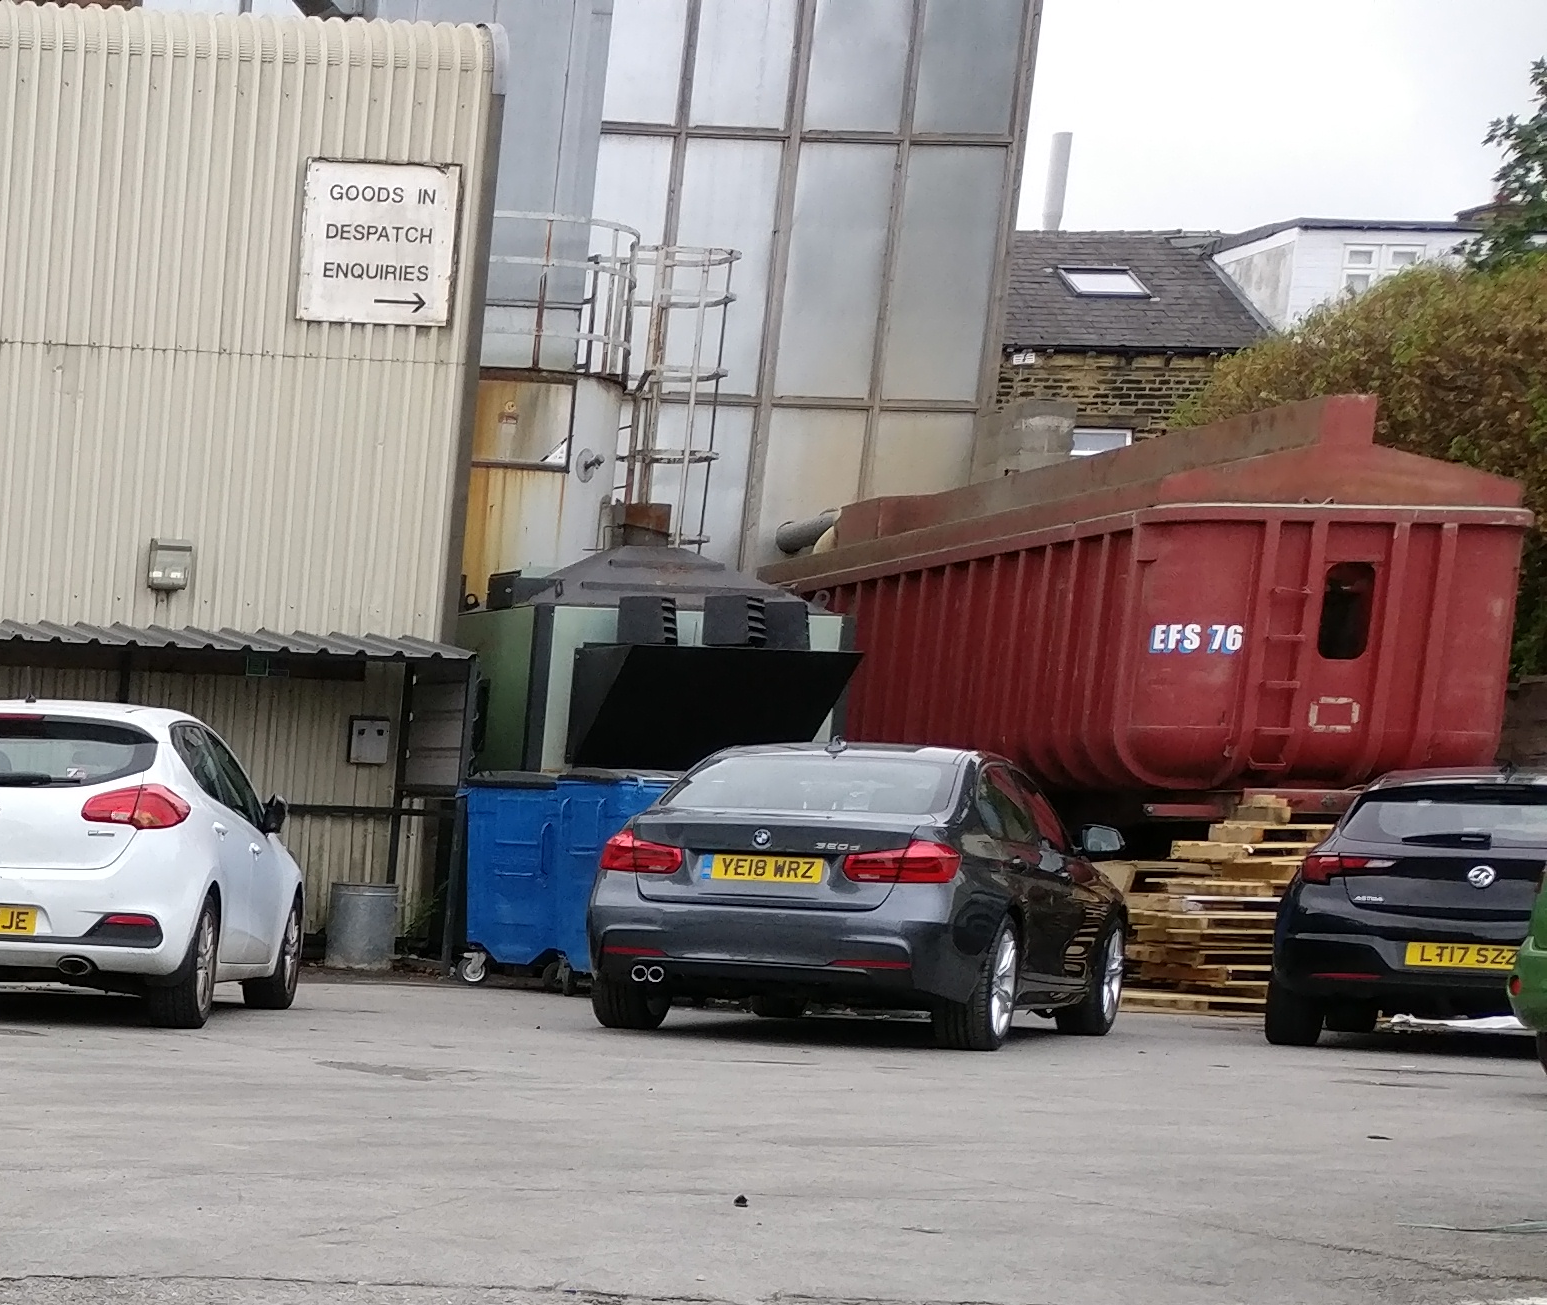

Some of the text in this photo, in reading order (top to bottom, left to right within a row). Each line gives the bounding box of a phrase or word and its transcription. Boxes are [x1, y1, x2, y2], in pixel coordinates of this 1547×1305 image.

[329, 184, 437, 205] GOODS IN
[325, 223, 433, 244] DESPATCH
[322, 261, 430, 282] ENQUIRIES
[1150, 624, 1244, 654] EFS 76
[722, 857, 816, 879] YE18 WRZ
[1420, 945, 1470, 963] LT17
